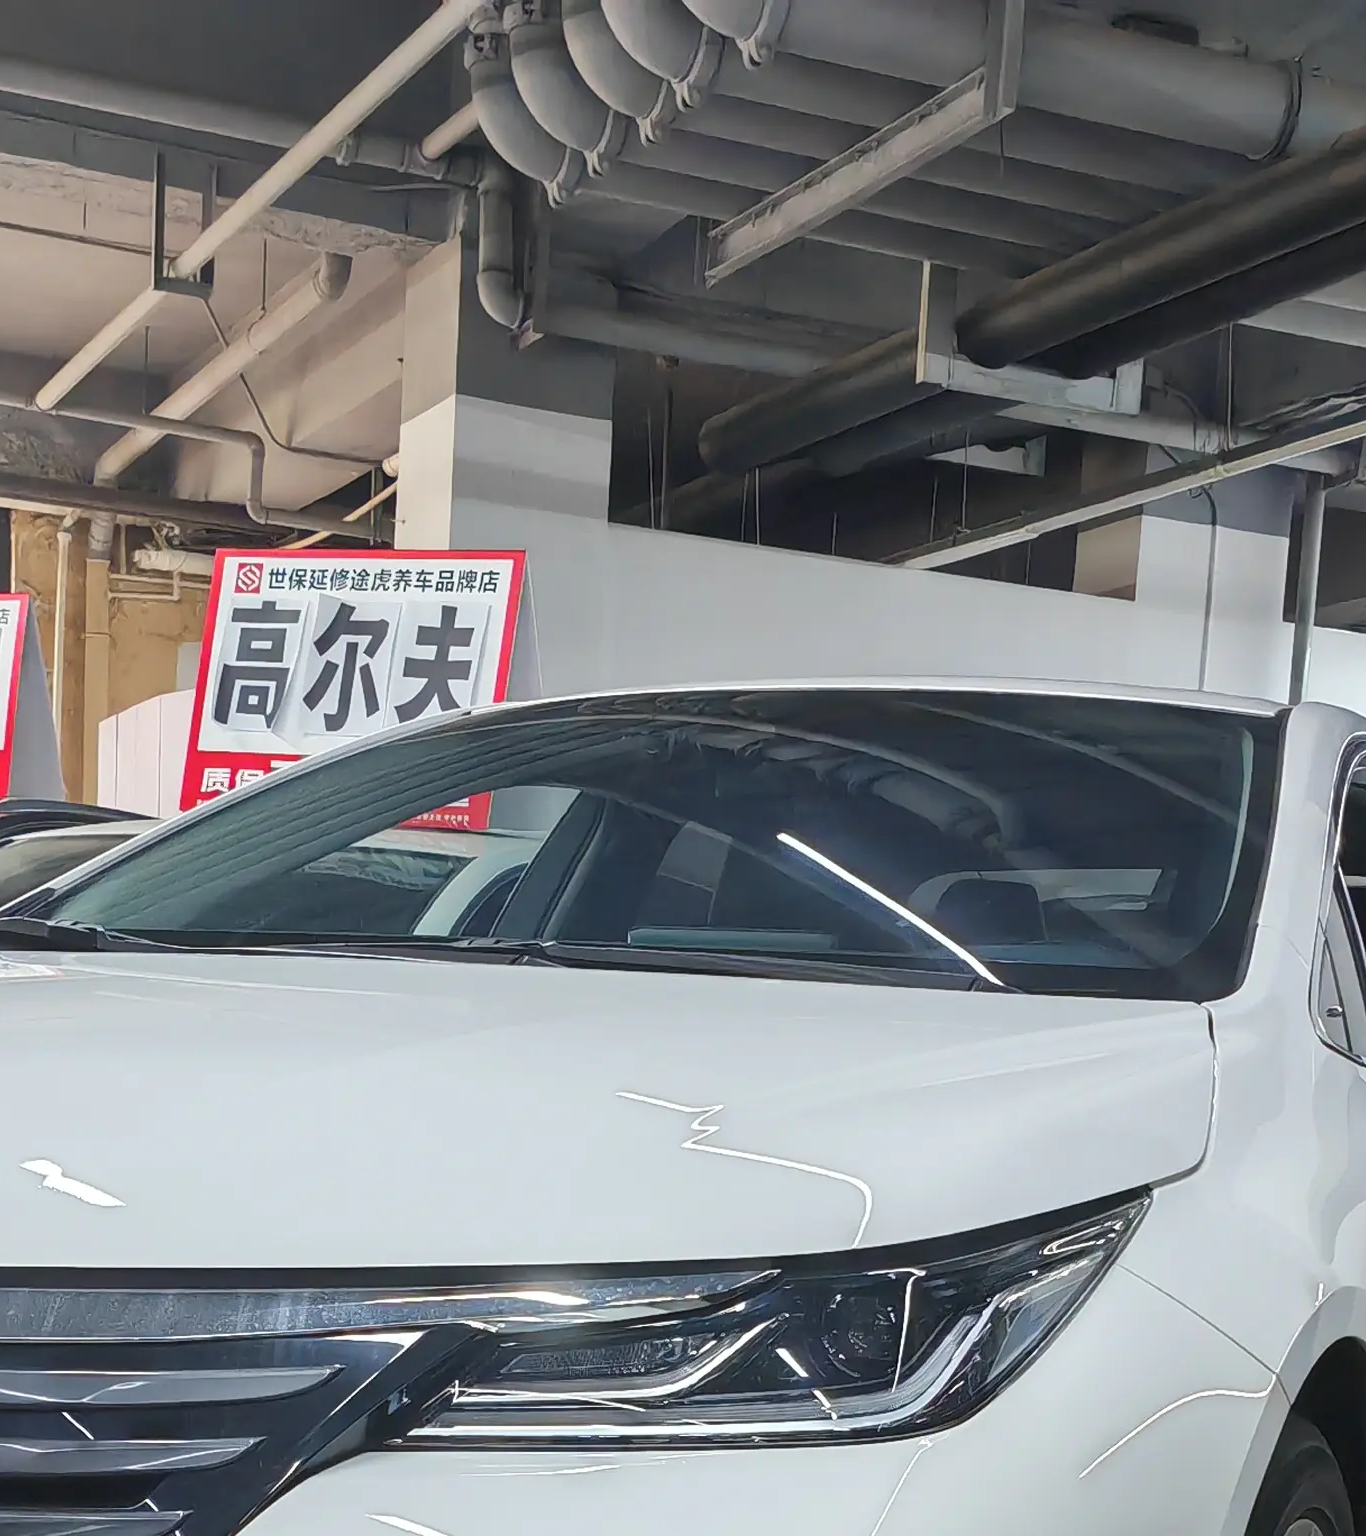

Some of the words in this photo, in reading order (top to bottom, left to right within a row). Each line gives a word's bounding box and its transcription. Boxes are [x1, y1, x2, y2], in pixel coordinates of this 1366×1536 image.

[268, 567, 501, 594] 世保延修途虎养车品牌店
[213, 600, 475, 732] 高尔夫
